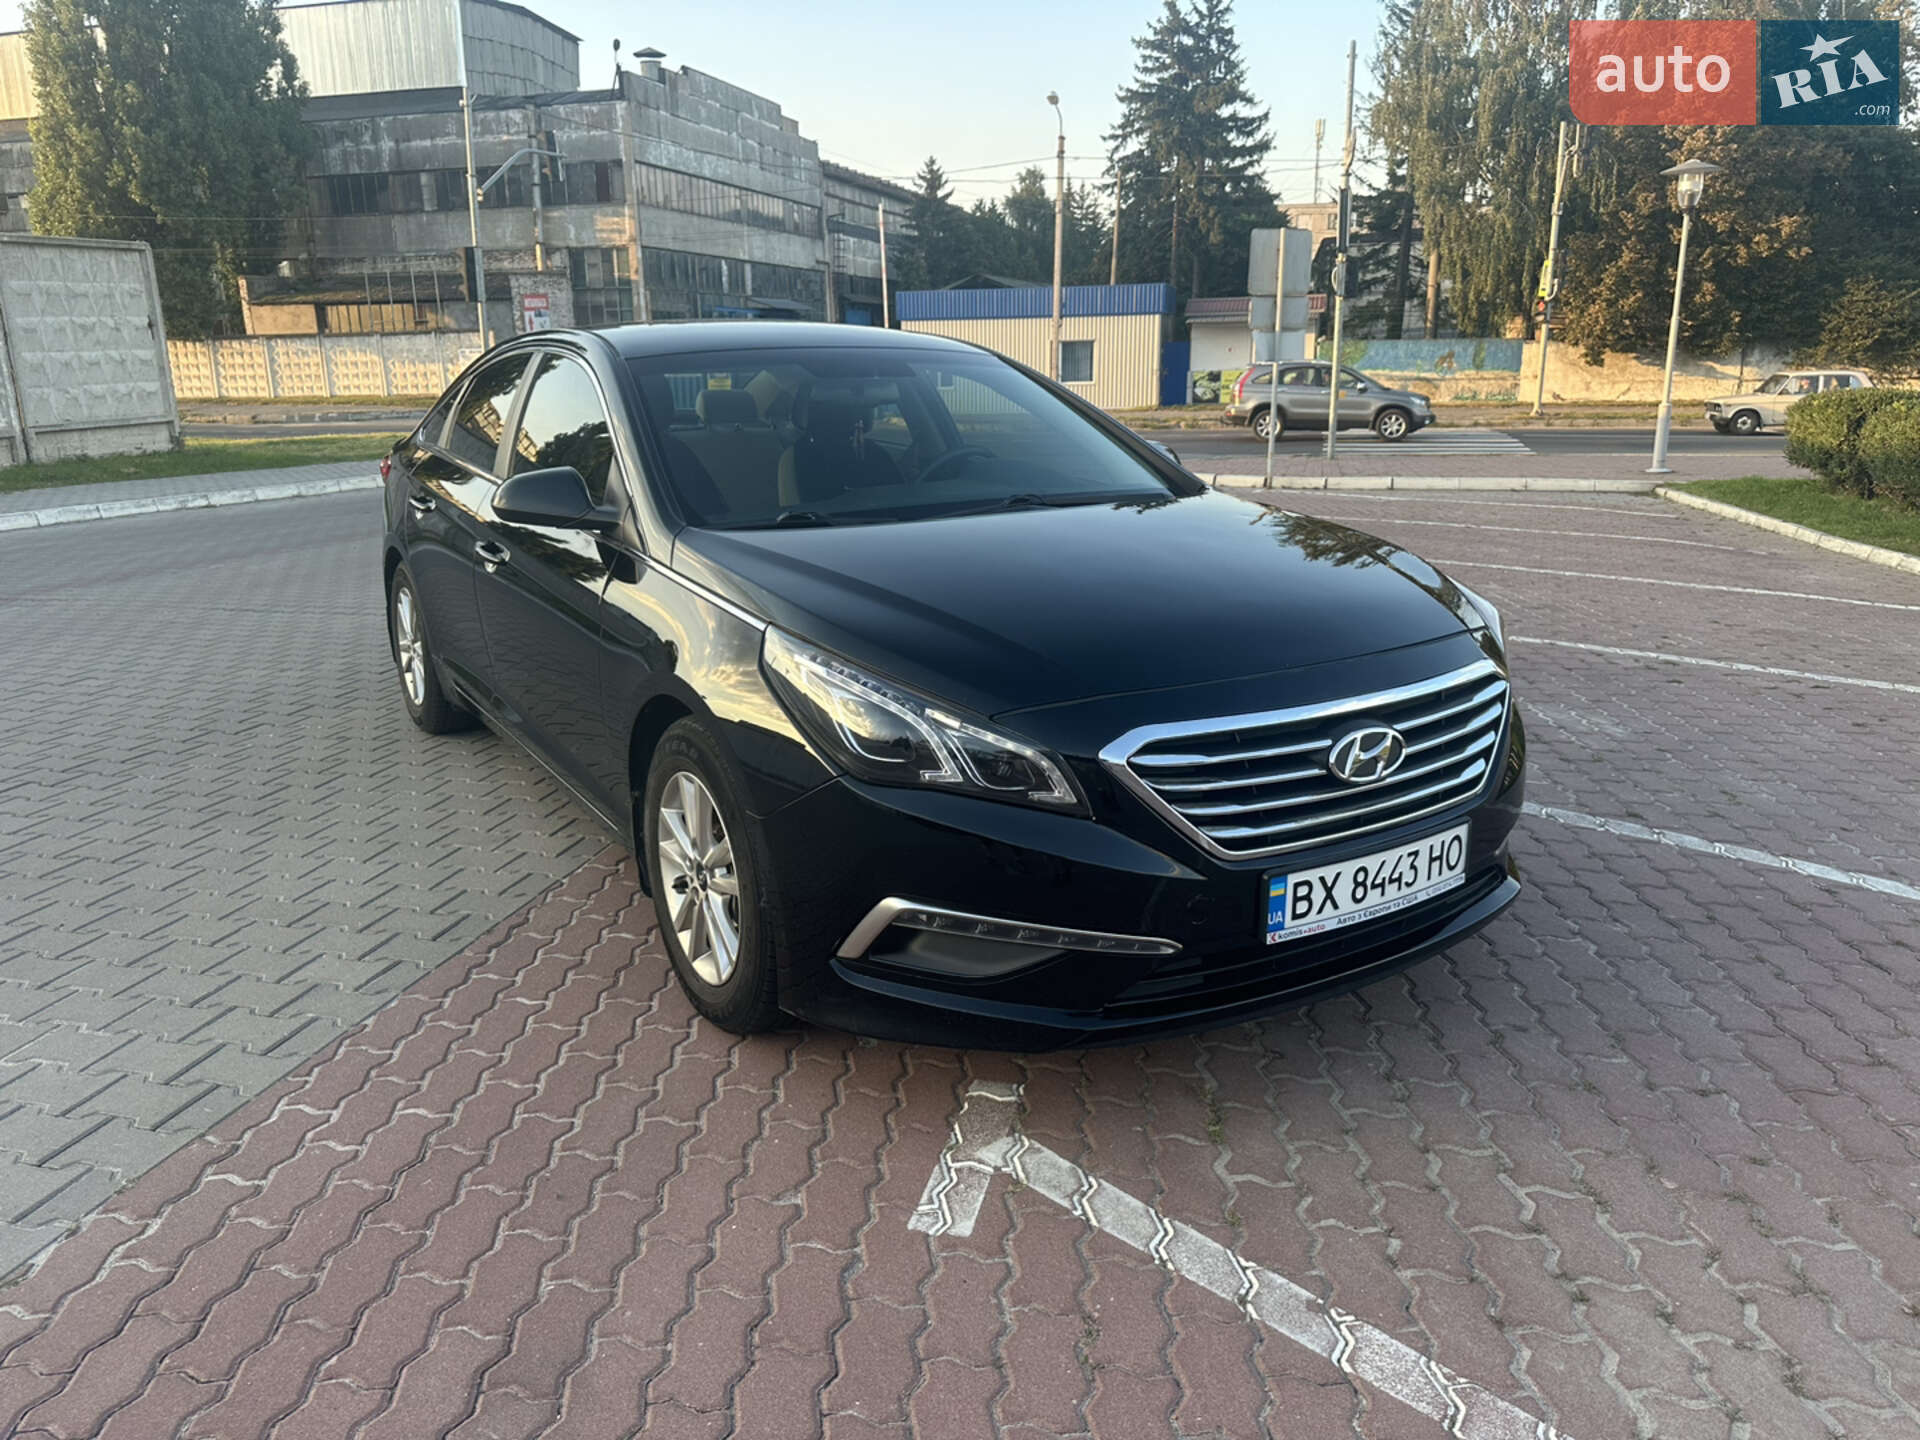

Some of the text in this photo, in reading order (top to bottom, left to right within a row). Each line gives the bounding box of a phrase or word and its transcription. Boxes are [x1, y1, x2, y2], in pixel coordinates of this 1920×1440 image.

[1291, 871, 1342, 921] BX
[1351, 849, 1419, 904] 8443
[1427, 834, 1462, 881] HO
[1268, 911, 1284, 925] UA
